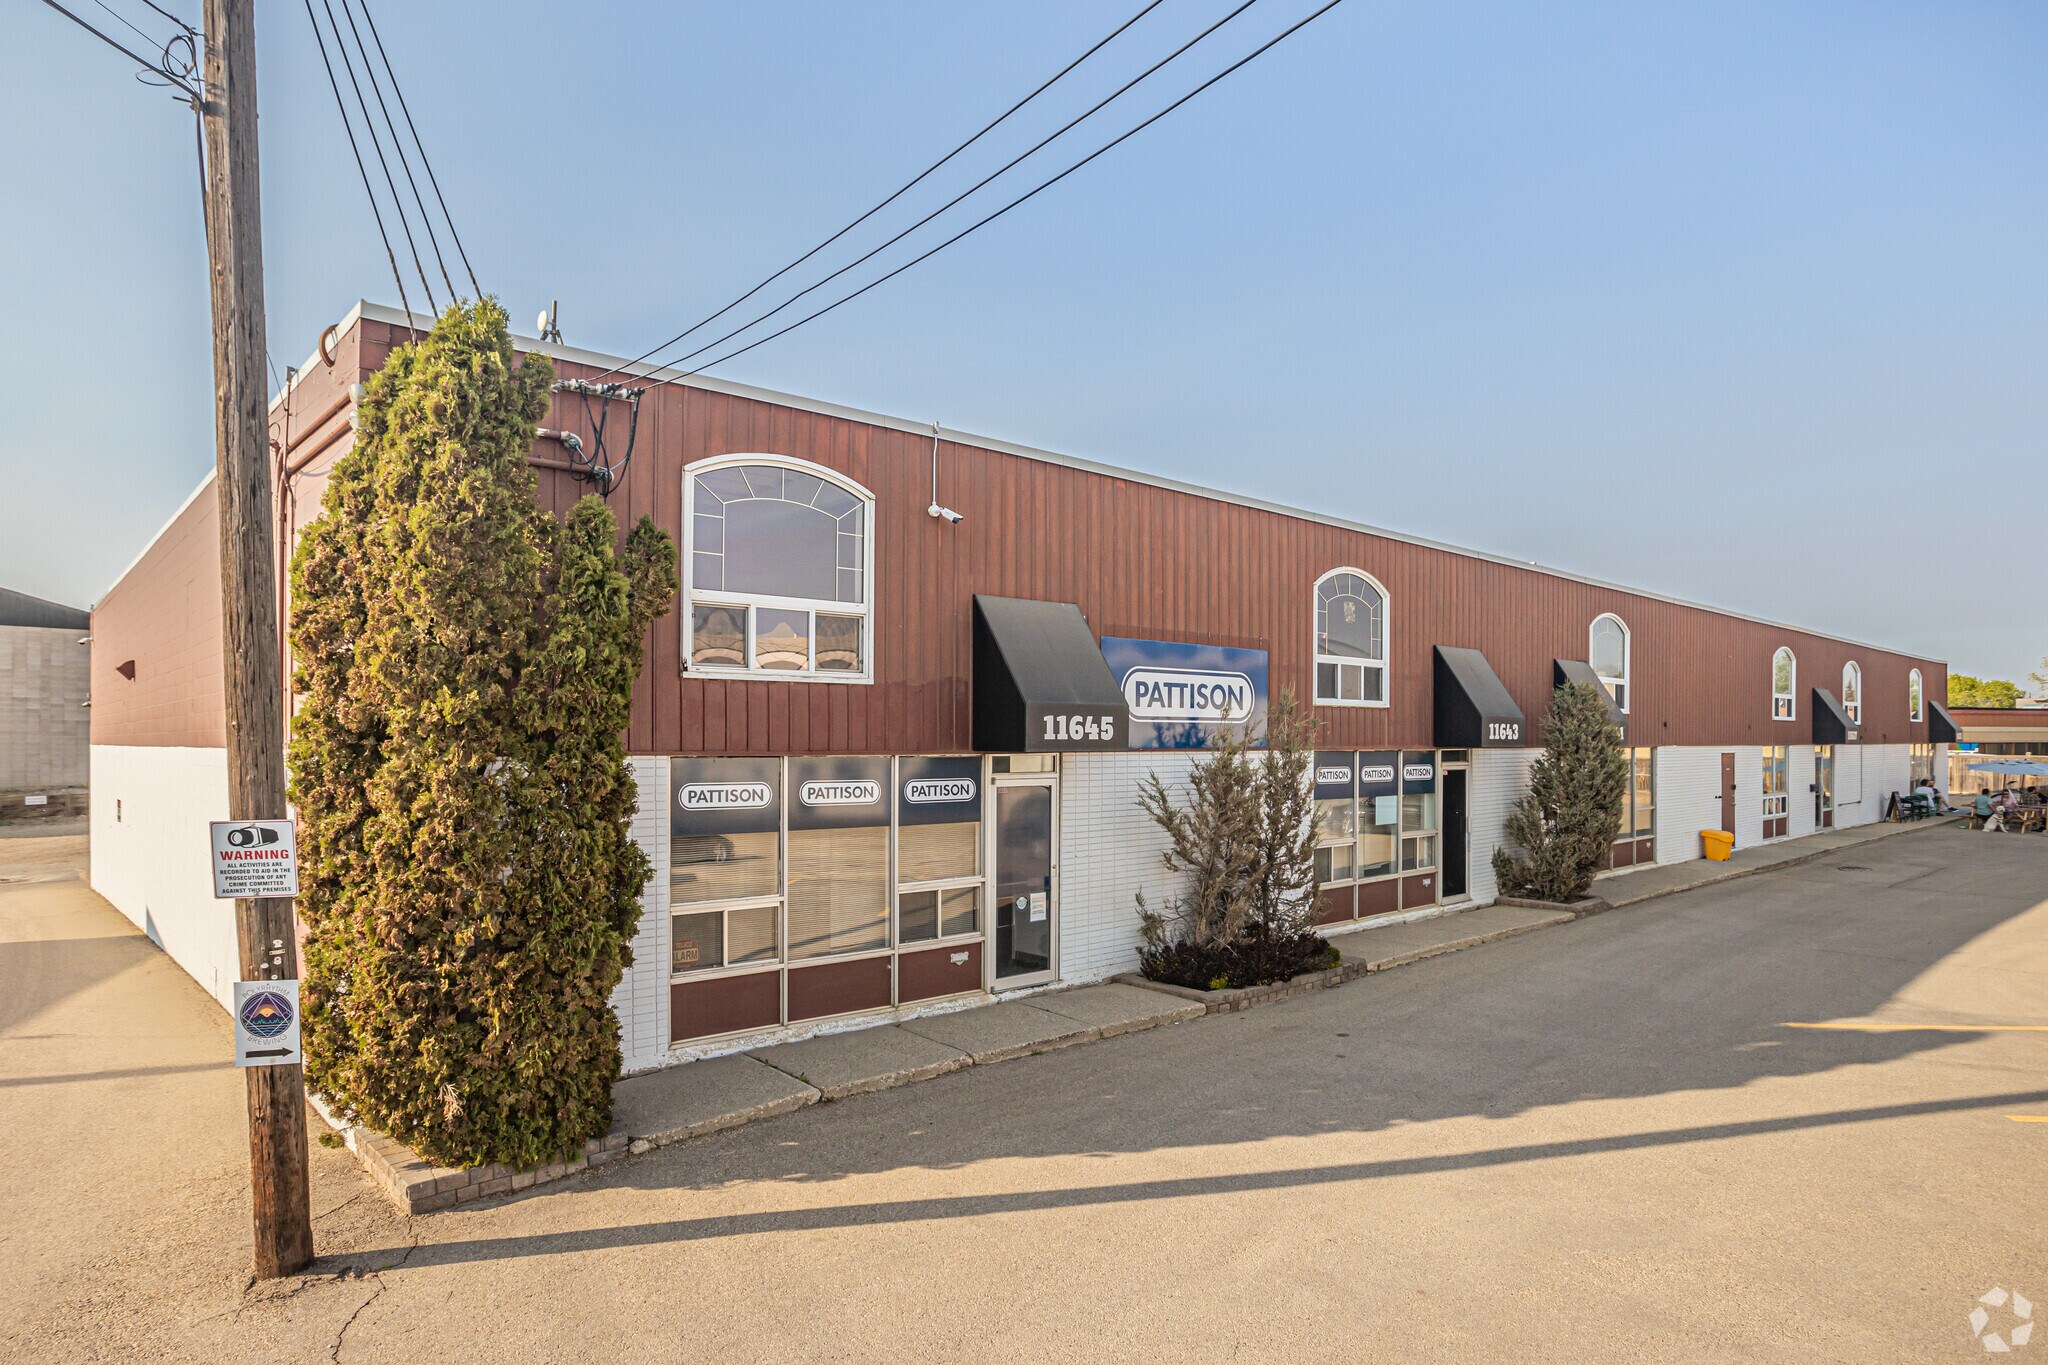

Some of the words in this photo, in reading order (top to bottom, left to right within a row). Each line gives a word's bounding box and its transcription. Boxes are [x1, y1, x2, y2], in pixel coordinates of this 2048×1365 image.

[1135, 681, 1244, 710] PATTISON
[1043, 715, 1114, 741] 11645
[1489, 723, 1519, 740] 11643
[1318, 770, 1349, 780] PATTISON
[1364, 769, 1392, 779] PATTISON
[1405, 768, 1431, 777] PATTISON
[687, 788, 764, 803] PATTISON
[807, 786, 874, 800] PATTISON
[911, 784, 970, 797] PATTISON
[220, 849, 289, 860] WARNING
[242, 984, 290, 999] POLYRHYTHM
[247, 1034, 288, 1045] BREWING
